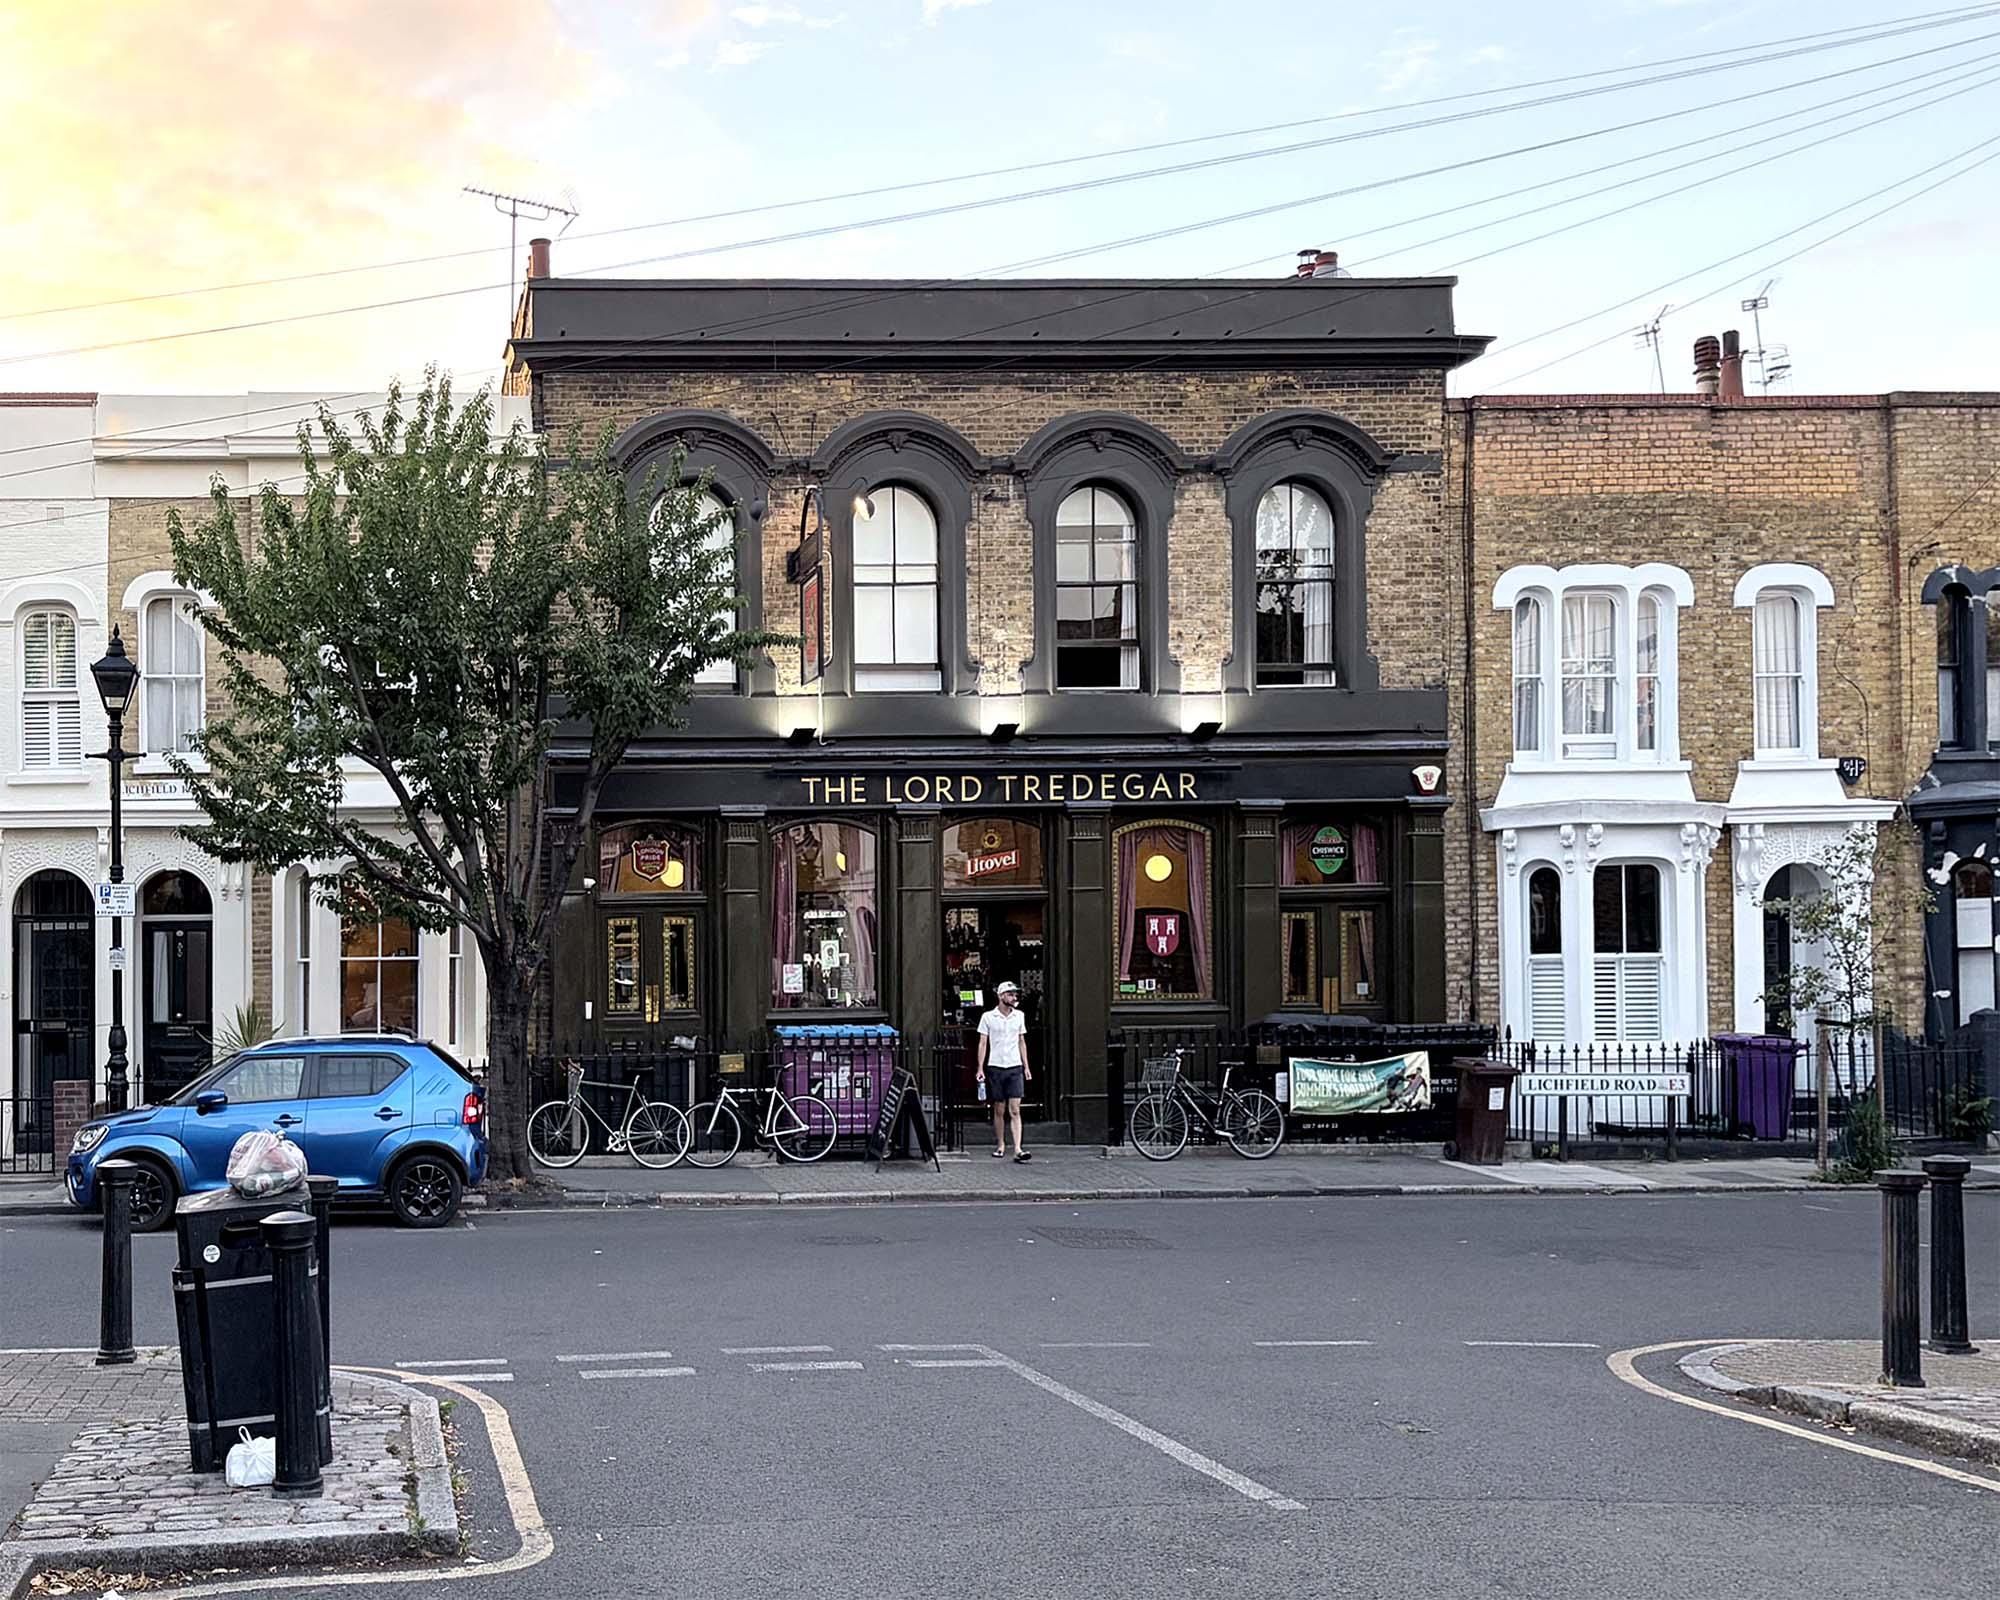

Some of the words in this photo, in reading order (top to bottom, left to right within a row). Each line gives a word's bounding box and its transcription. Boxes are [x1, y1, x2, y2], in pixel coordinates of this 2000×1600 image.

[122, 784, 177, 795] ICHFIELD
[801, 776, 867, 804] THE
[884, 775, 983, 803] LORD
[997, 772, 1199, 802] TREDEGAR
[1312, 846, 1344, 855] CHISWICK
[1295, 1068, 1316, 1082] YOUR
[1316, 1068, 1340, 1083] HOME
[1340, 1068, 1357, 1082] FOR
[1358, 1067, 1376, 1082] THIS
[1295, 1081, 1339, 1098] SUMMER'S
[1527, 1078, 1610, 1091] LICHFIELD
[1614, 1078, 1657, 1091] ROAD
[1668, 1078, 1686, 1091] E3
